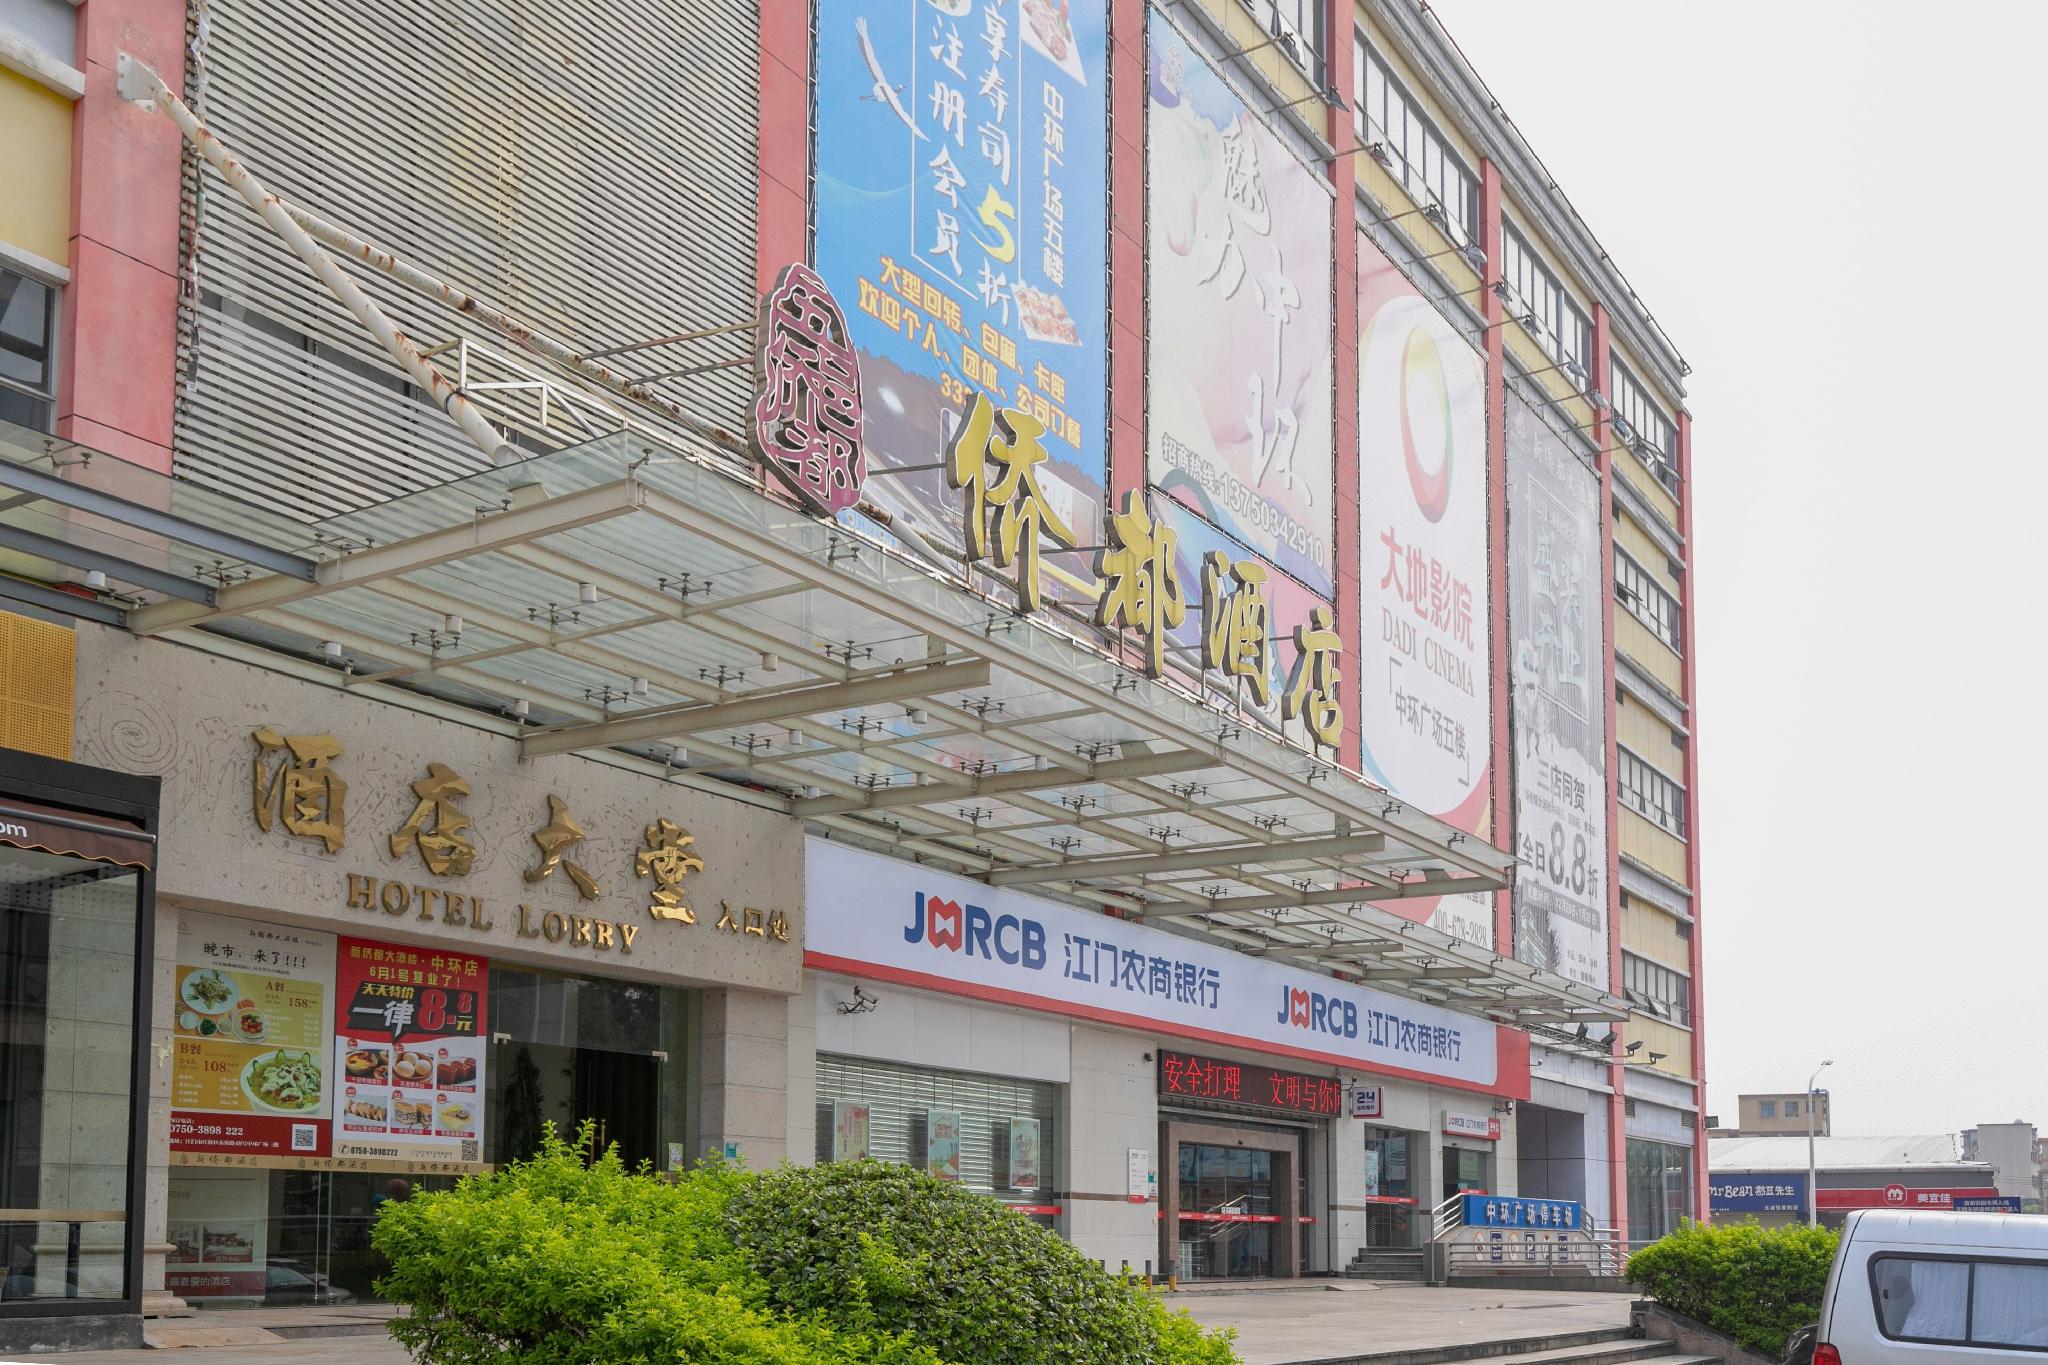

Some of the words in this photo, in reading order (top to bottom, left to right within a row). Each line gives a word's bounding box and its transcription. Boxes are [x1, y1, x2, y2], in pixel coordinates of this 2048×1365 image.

[928, 14, 967, 276] 注册会员
[1043, 80, 1064, 288] 中环广场五楼
[945, 390, 1344, 749] 侨都酒店
[1379, 526, 1474, 652] 大地影院
[1382, 606, 1417, 661] DADI
[1424, 636, 1475, 697] CINEMA
[251, 726, 704, 926] 酒店大堂
[346, 872, 494, 932] HOTEL
[518, 904, 639, 955] LOBBY
[715, 900, 792, 943] 入口处
[361, 982, 415, 999] 天天特价
[1063, 933, 1220, 1009] 江门农商银行
[204, 1060, 227, 1073] 108
[1367, 1009, 1461, 1062] 江门农商银行
[1356, 1091, 1375, 1103] 24
[1486, 1200, 1573, 1227] 中环广场停车场
[1917, 1192, 1951, 1203] 美宜佳
